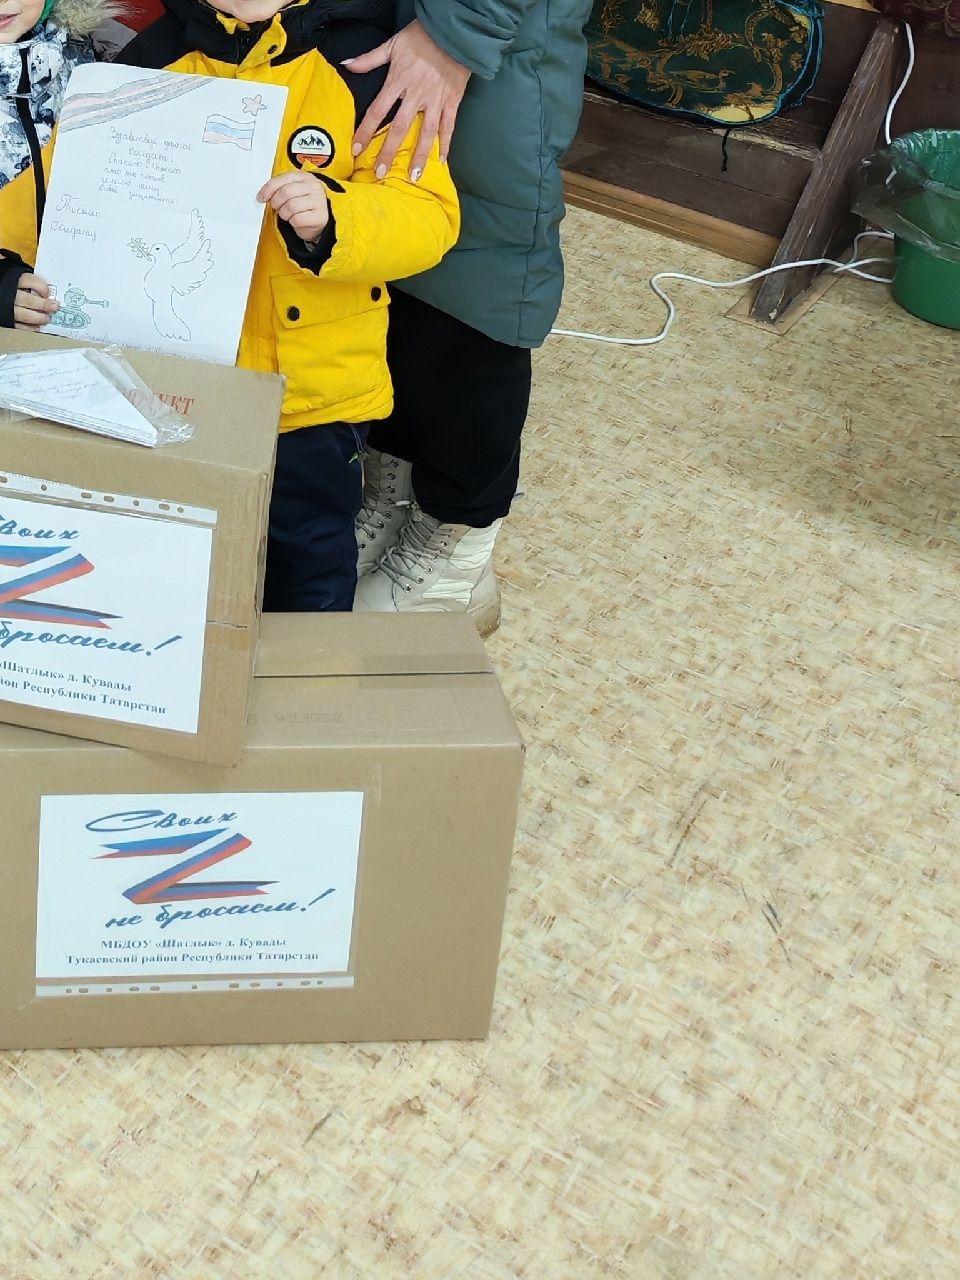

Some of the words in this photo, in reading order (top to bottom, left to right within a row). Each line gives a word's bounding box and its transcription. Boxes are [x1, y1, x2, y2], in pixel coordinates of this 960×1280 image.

[23, 681, 96, 702] Республики
[100, 693, 166, 714] Татарстан
[85, 809, 238, 833] Своих
[105, 915, 144, 928] не
[155, 888, 336, 929] бросаем!
[101, 939, 152, 949] МБДОУ
[155, 938, 222, 949] «Шатлык»
[66, 954, 138, 965] Тукаевский
[141, 954, 179, 965] район
[181, 953, 253, 965] Республики
[256, 951, 319, 964] Татарстан
